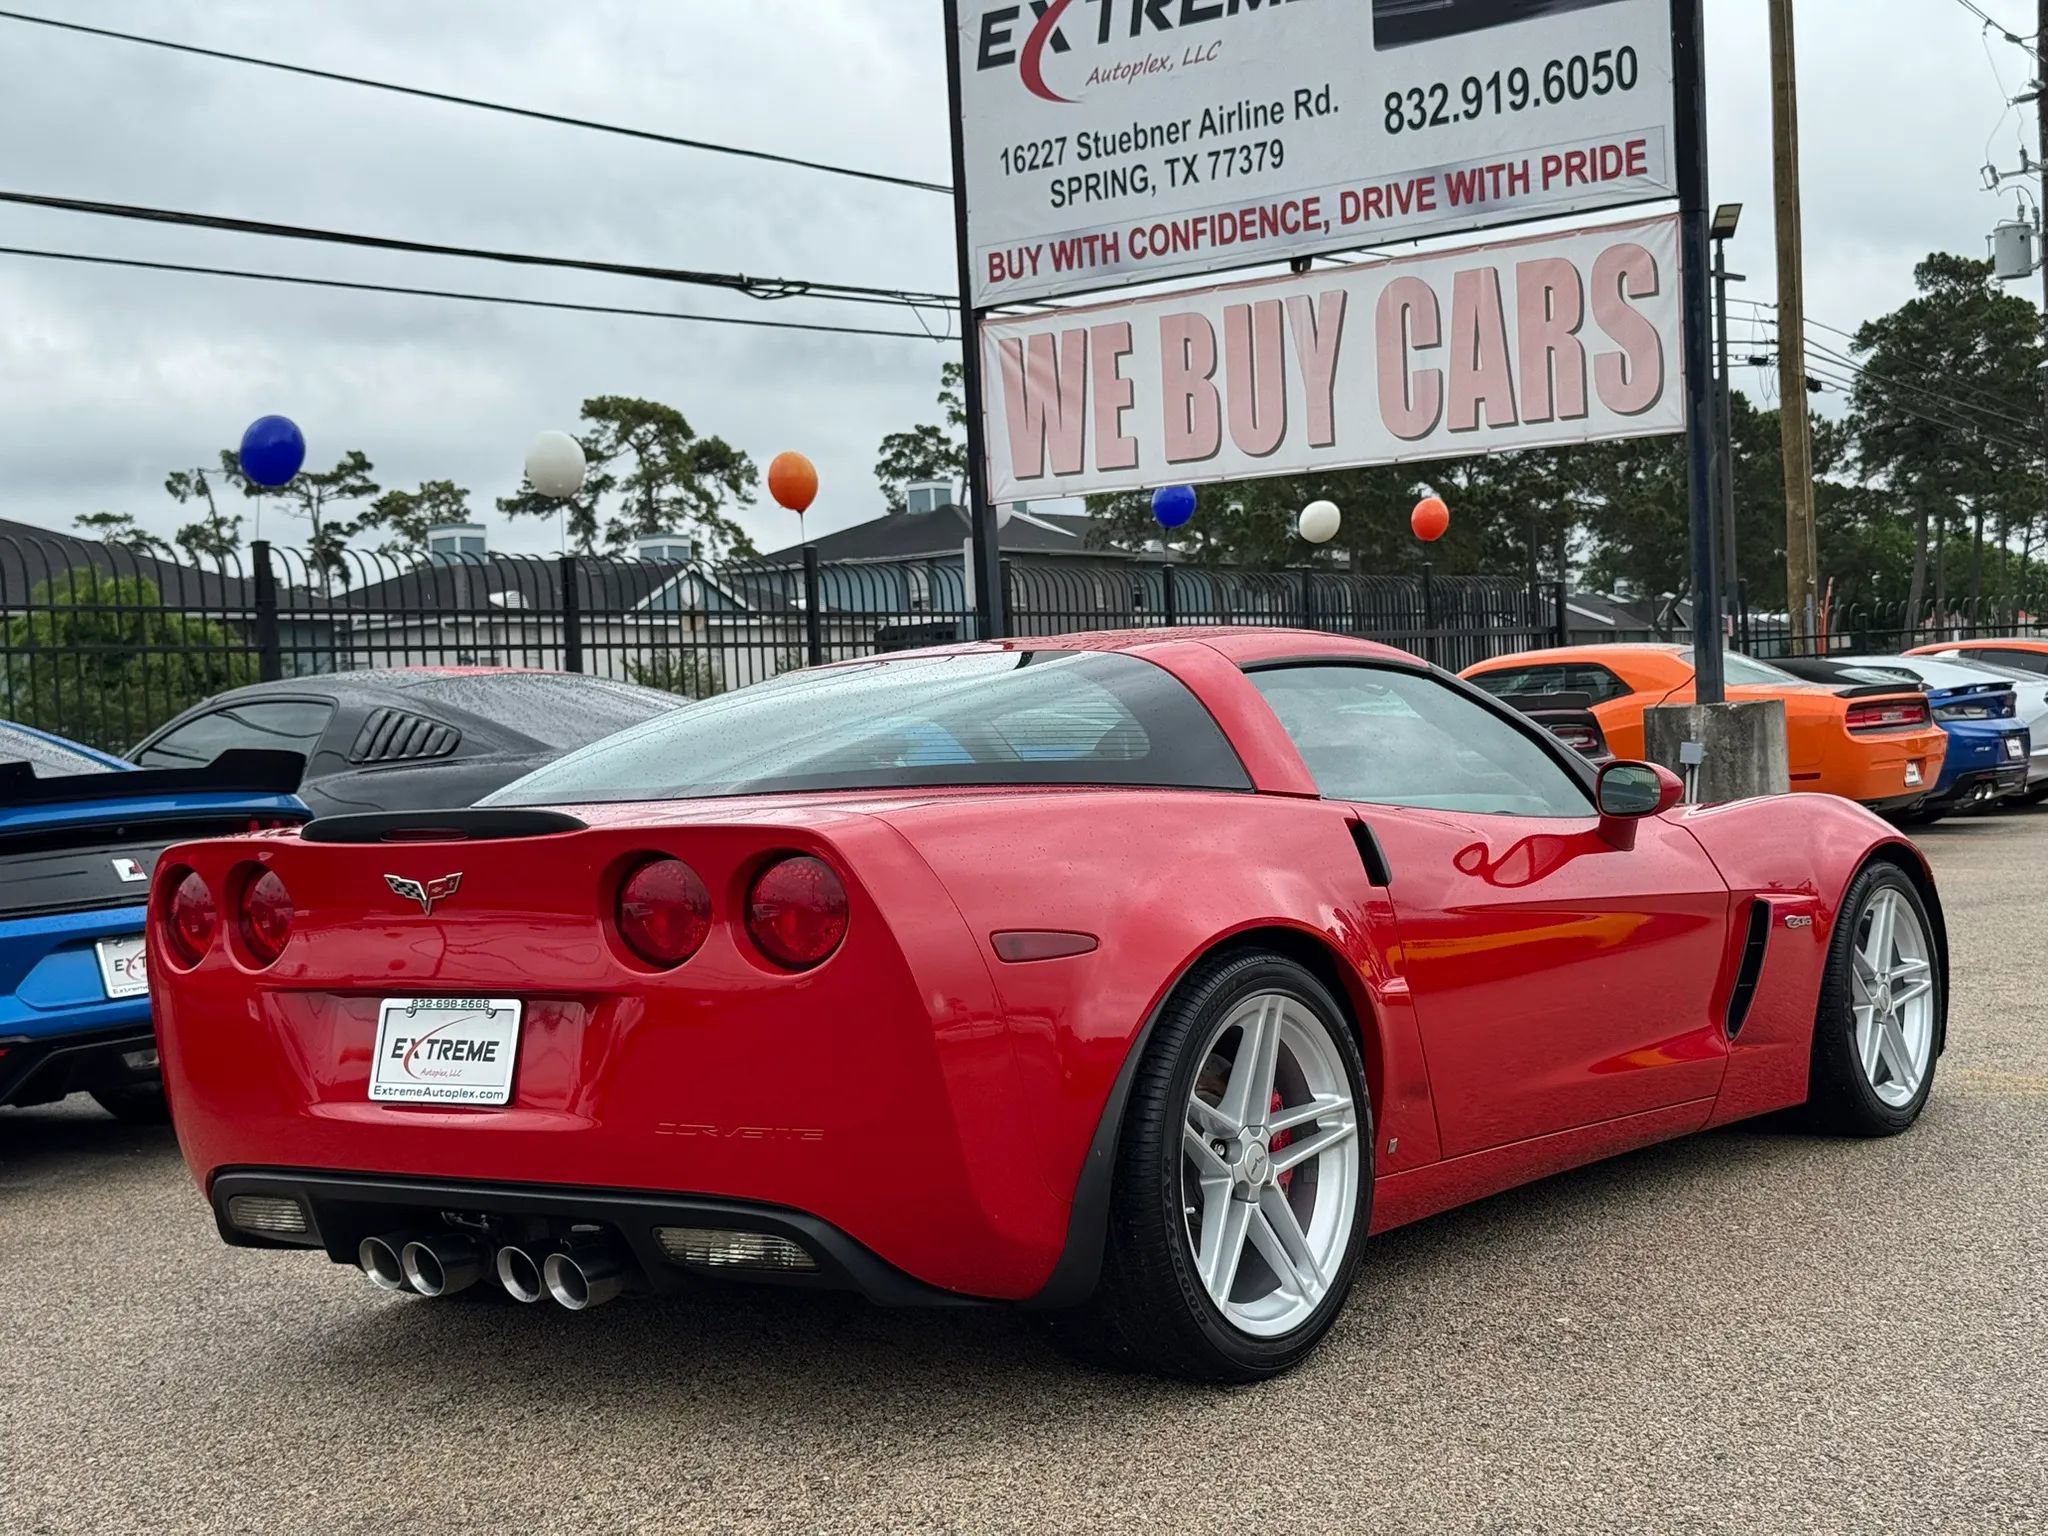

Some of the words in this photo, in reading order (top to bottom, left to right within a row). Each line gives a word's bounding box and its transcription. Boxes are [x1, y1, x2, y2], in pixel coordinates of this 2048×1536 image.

[1085, 53, 1174, 86] Autoplex,
[1182, 40, 1222, 67] LLC
[1384, 45, 1638, 135] 832.919.6050
[1000, 137, 1067, 176] 16227
[1076, 119, 1191, 161] Stuebner
[1199, 100, 1285, 139] Airline
[1294, 83, 1339, 120] Rd.
[1050, 164, 1157, 208] SPRING,
[1165, 154, 1200, 187] TX
[1208, 139, 1284, 181] 77379
[988, 245, 1043, 283] BUY
[1050, 231, 1120, 273] WITH
[1128, 197, 1331, 260] CONFIDENCE,
[1340, 176, 1436, 225] DRIVE
[1445, 160, 1530, 207] WITH
[1541, 139, 1648, 191] PRIDE
[1000, 320, 1139, 480] WE
[1158, 289, 1348, 465] BUY
[1374, 242, 1665, 441] CARS
[391, 1038, 500, 1062] EXTREME
[373, 1085, 504, 1100] ExtremeAutoplex.com
[655, 1122, 825, 1141] CORVETTE
